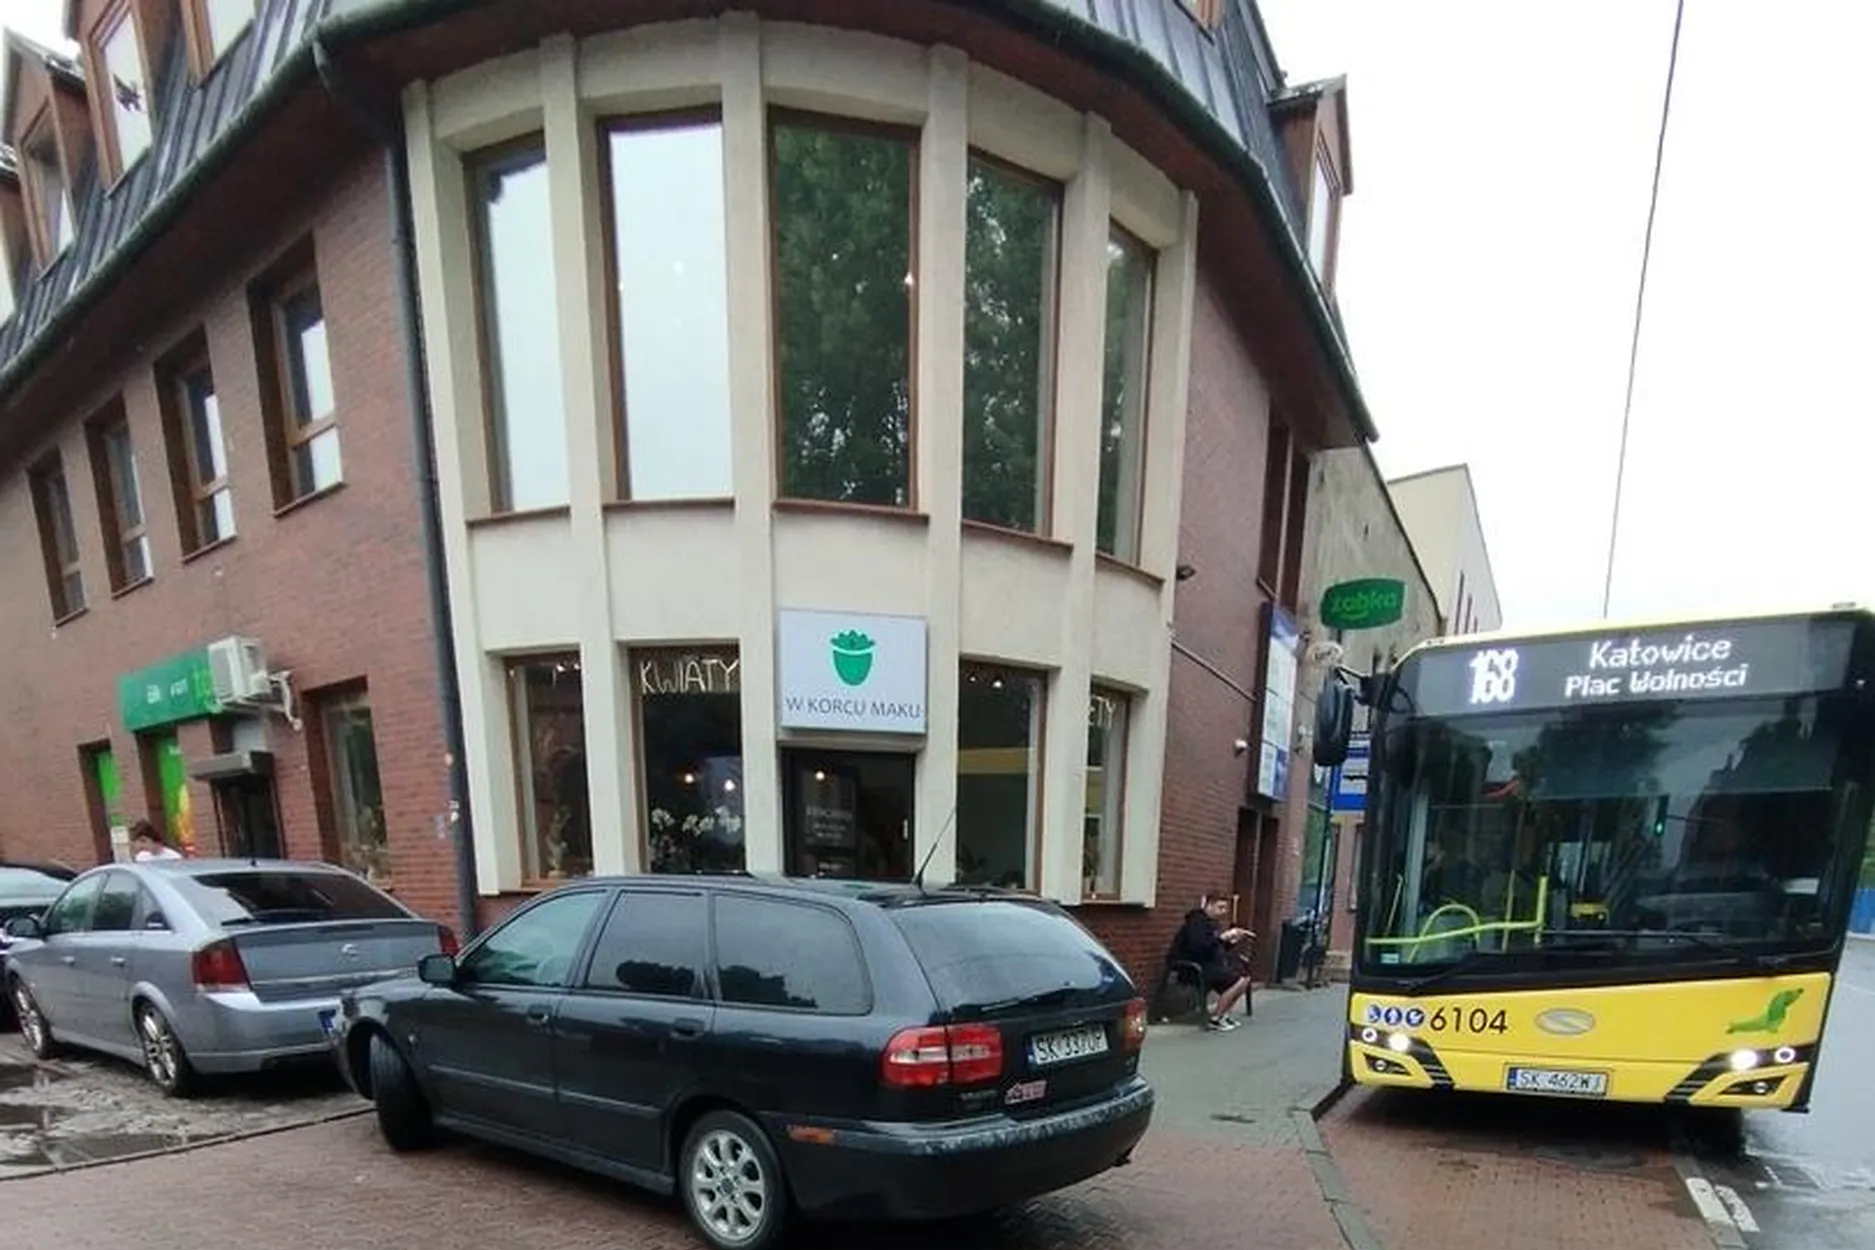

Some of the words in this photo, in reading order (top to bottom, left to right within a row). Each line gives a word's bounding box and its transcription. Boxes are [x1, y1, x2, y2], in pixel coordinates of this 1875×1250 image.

[1589, 634, 1732, 669] Katowice
[640, 655, 740, 695] KWIATY
[1564, 674, 1621, 698] Plac
[1628, 663, 1749, 694] Wolności
[785, 697, 803, 712] W
[807, 697, 867, 716] KORCU
[870, 701, 921, 718] MAKU
[1430, 1006, 1508, 1035] 6104
[1036, 1034, 1060, 1061] SK
[1519, 1070, 1540, 1087] SK
